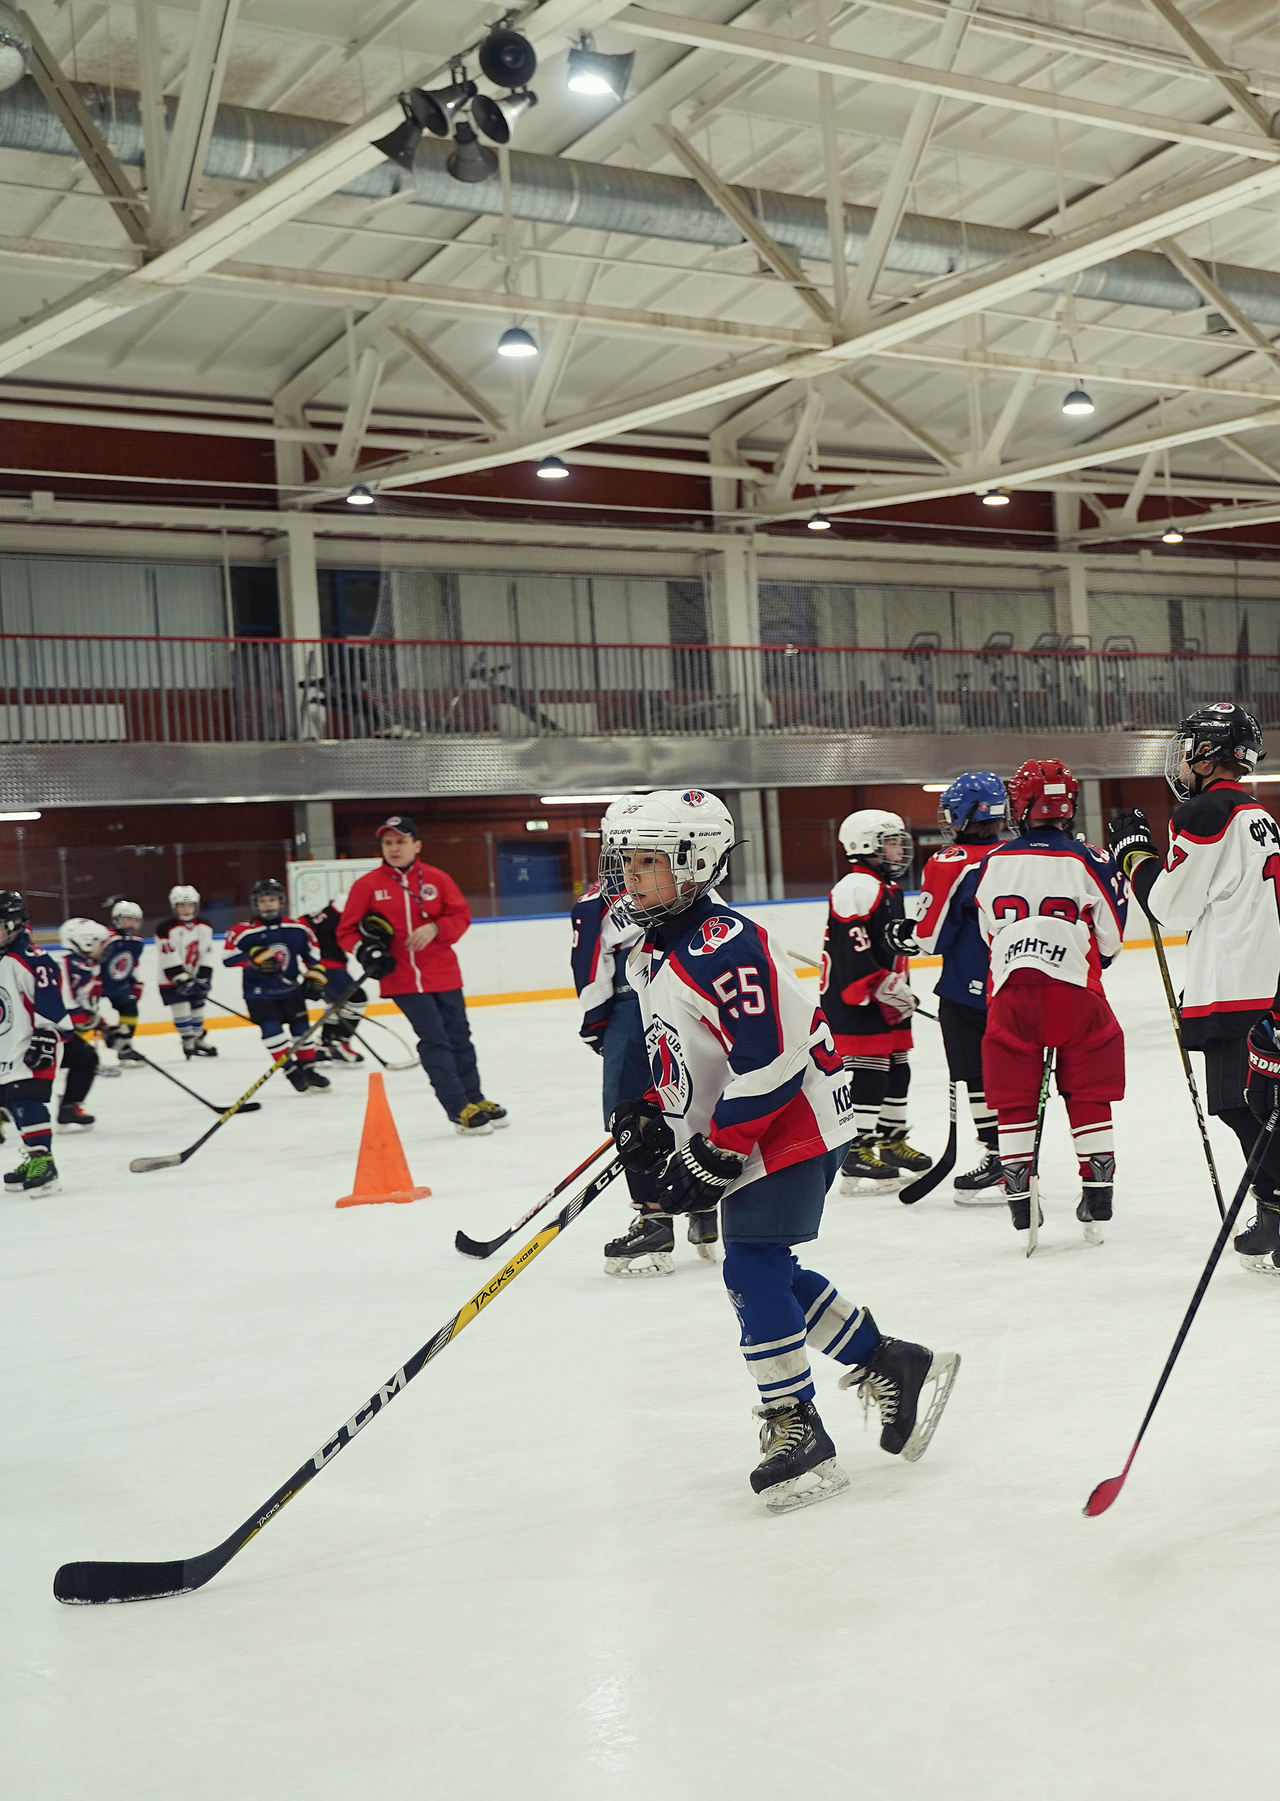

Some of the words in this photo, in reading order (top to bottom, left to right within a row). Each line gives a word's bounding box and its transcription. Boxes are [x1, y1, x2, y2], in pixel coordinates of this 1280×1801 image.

[711, 966, 766, 1019] 55
[594, 1161, 624, 1190] CC
[680, 1139, 735, 1187] WARRIO
[470, 1265, 515, 1311] TACKS
[516, 1242, 540, 1264] 4092
[310, 1366, 408, 1471] CCM
[256, 1503, 280, 1527] TACKS
